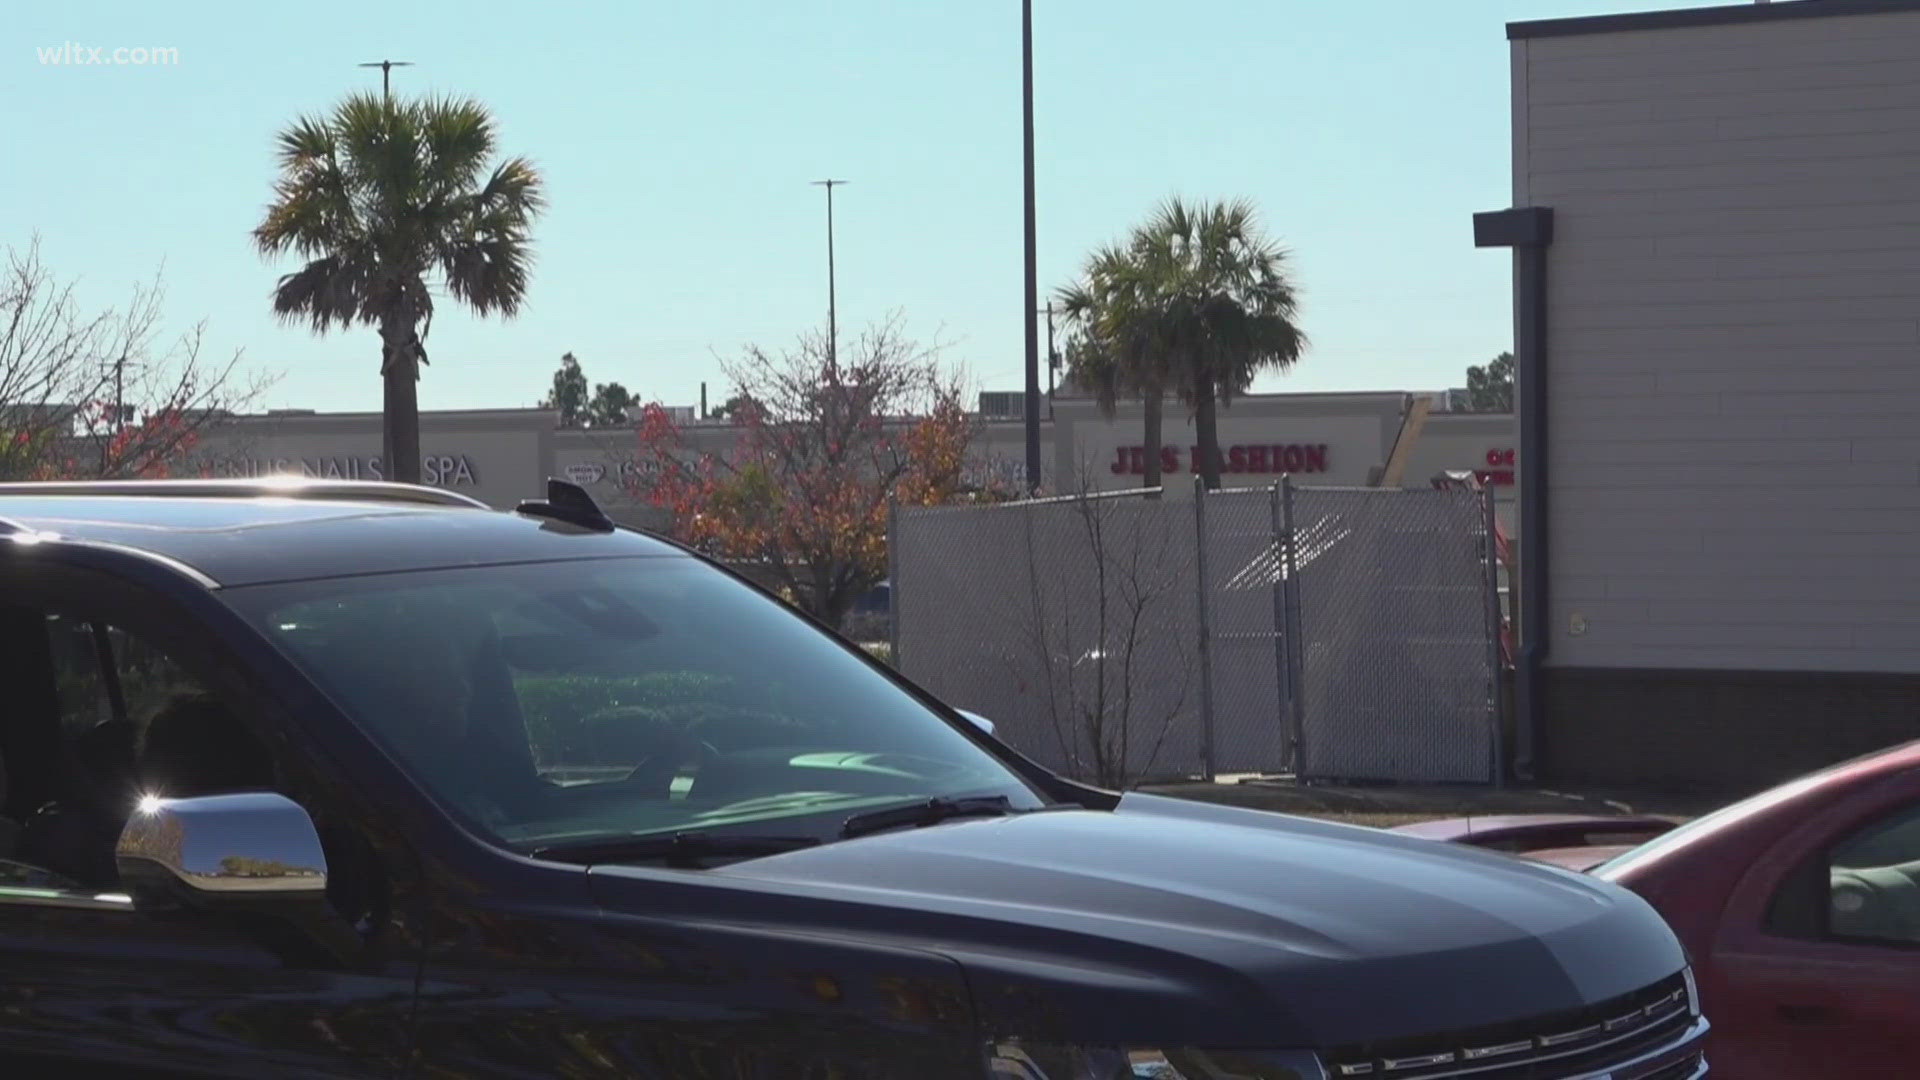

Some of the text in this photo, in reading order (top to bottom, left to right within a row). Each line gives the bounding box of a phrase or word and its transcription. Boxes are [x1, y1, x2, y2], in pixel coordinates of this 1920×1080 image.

[301, 457, 384, 481] NAILS
[423, 455, 476, 485] SPA
[1190, 444, 1328, 475] FSHION
